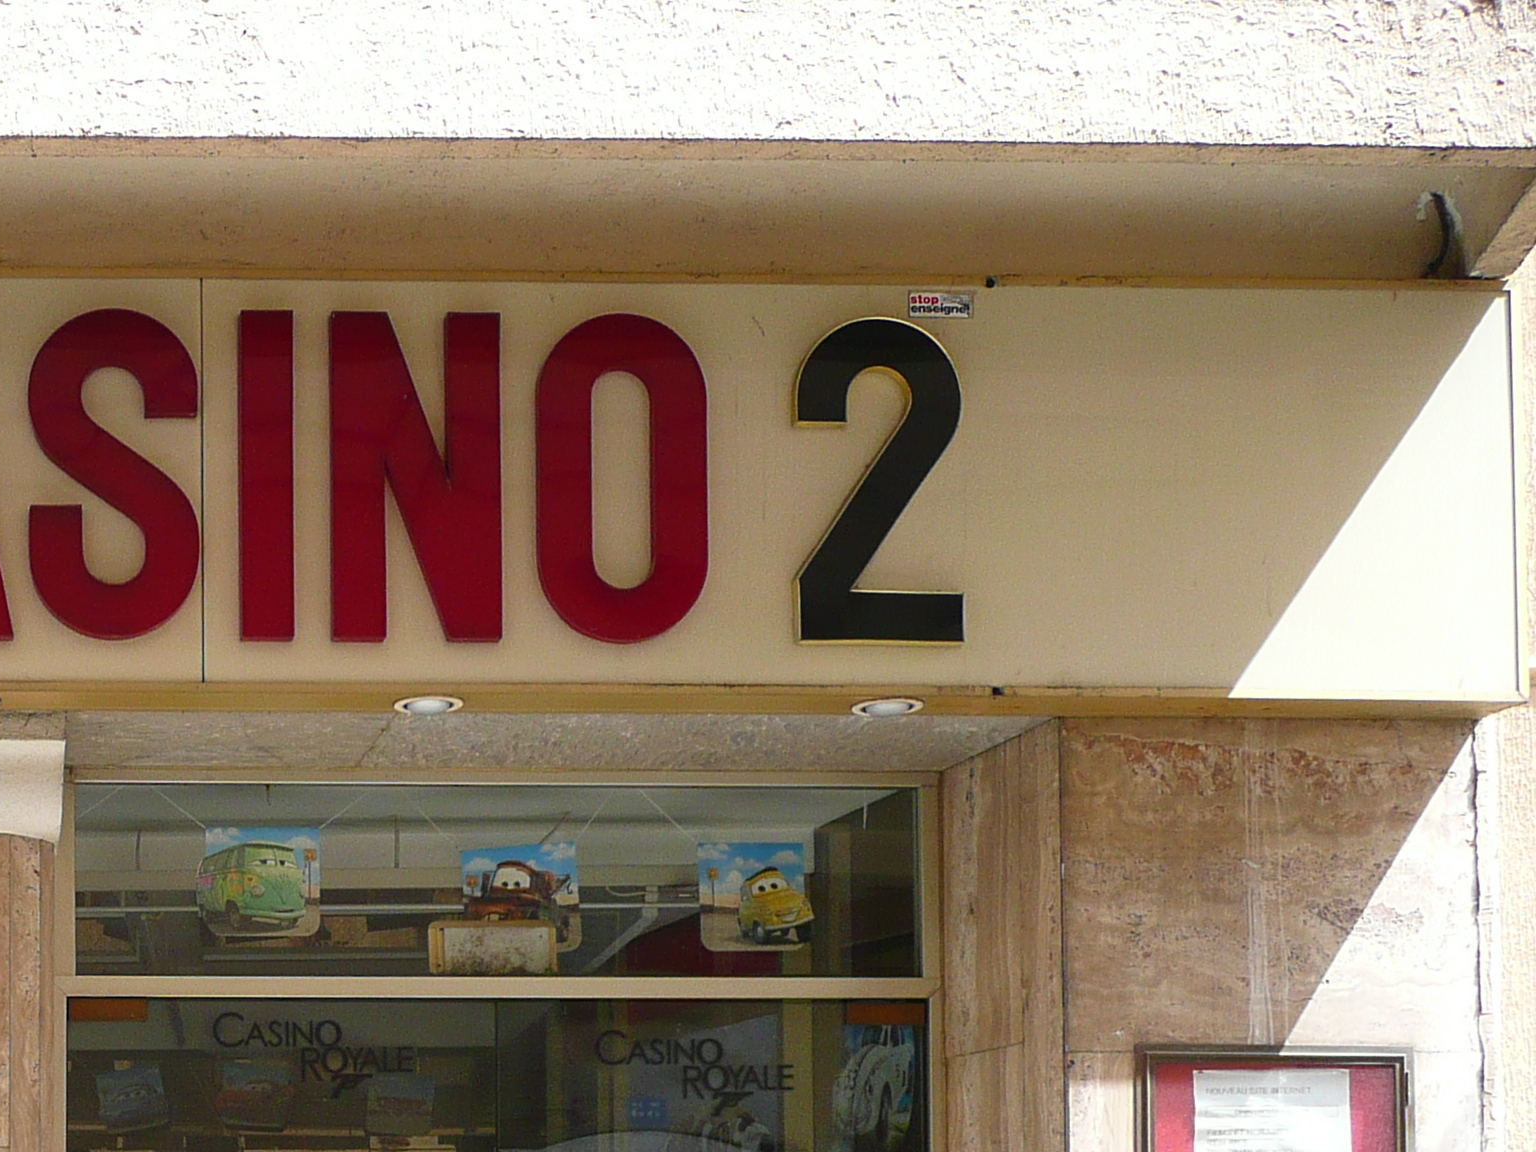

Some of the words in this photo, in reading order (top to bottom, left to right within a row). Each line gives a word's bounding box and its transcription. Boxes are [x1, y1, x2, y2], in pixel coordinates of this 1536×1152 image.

[910, 294, 939, 305] stop
[792, 315, 966, 645] 2
[212, 1012, 343, 1049] CASINO
[595, 1030, 723, 1067] CASINO
[299, 1045, 415, 1082] ROYALE
[683, 1062, 795, 1099] ROYALE
